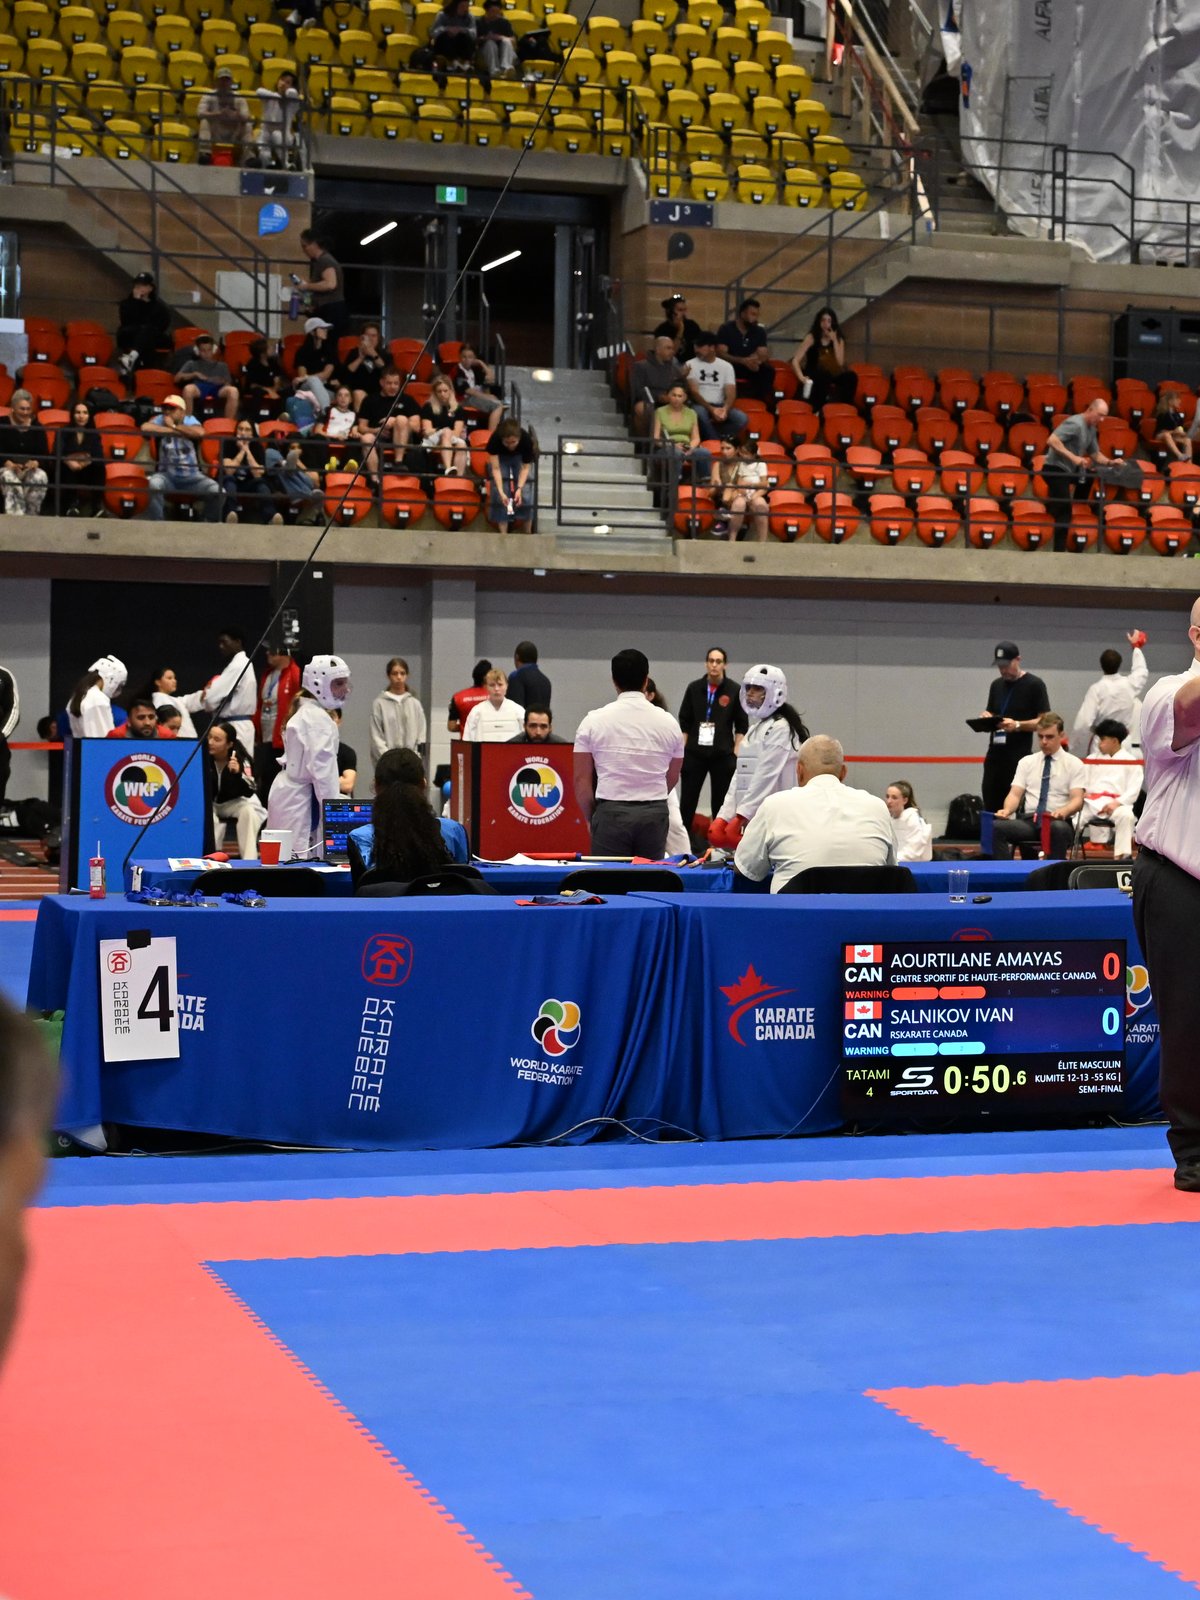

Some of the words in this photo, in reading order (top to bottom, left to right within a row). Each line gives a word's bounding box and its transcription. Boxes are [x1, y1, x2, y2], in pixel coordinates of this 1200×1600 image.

[124, 782, 159, 797] WKF
[519, 783, 552, 797] WKF
[890, 953, 991, 968] AOURTILANE
[996, 952, 1062, 966] AMAYAS
[1103, 952, 1120, 980] 0
[844, 967, 882, 982] CAN
[890, 974, 922, 983] CENTRE
[924, 974, 956, 982] SPORTIF
[958, 974, 969, 982] DE
[971, 972, 1060, 981] HAUTE-PERFORMANCE
[1062, 972, 1097, 980] CANADA
[138, 966, 174, 1032] 4
[846, 990, 890, 998] WARNING
[755, 1008, 815, 1023] KARATE
[890, 1009, 970, 1024] SALNIKOV
[976, 1008, 1014, 1022] IVAN
[1102, 1007, 1120, 1035] 0
[755, 1024, 816, 1040] CANADA
[844, 1023, 882, 1039] CAN
[890, 1030, 931, 1039] RSKARATE
[933, 1030, 968, 1038] CANADA
[845, 1046, 889, 1055] WARNING
[510, 1057, 549, 1071] WORLD
[550, 1064, 583, 1075] KARATE
[1058, 1060, 1078, 1070] ÉLITE
[1080, 1061, 1121, 1069] MASCULIN
[517, 1070, 574, 1086] FEDERATION
[846, 1069, 890, 1080] TATAMI
[1035, 1074, 1064, 1083] KUMITE
[1067, 1073, 1089, 1082] 12-13
[1091, 1073, 1104, 1081] -55
[1106, 1072, 1117, 1080] KG
[866, 1087, 874, 1097] 4
[1079, 1085, 1123, 1093] SEMI-FINAL
